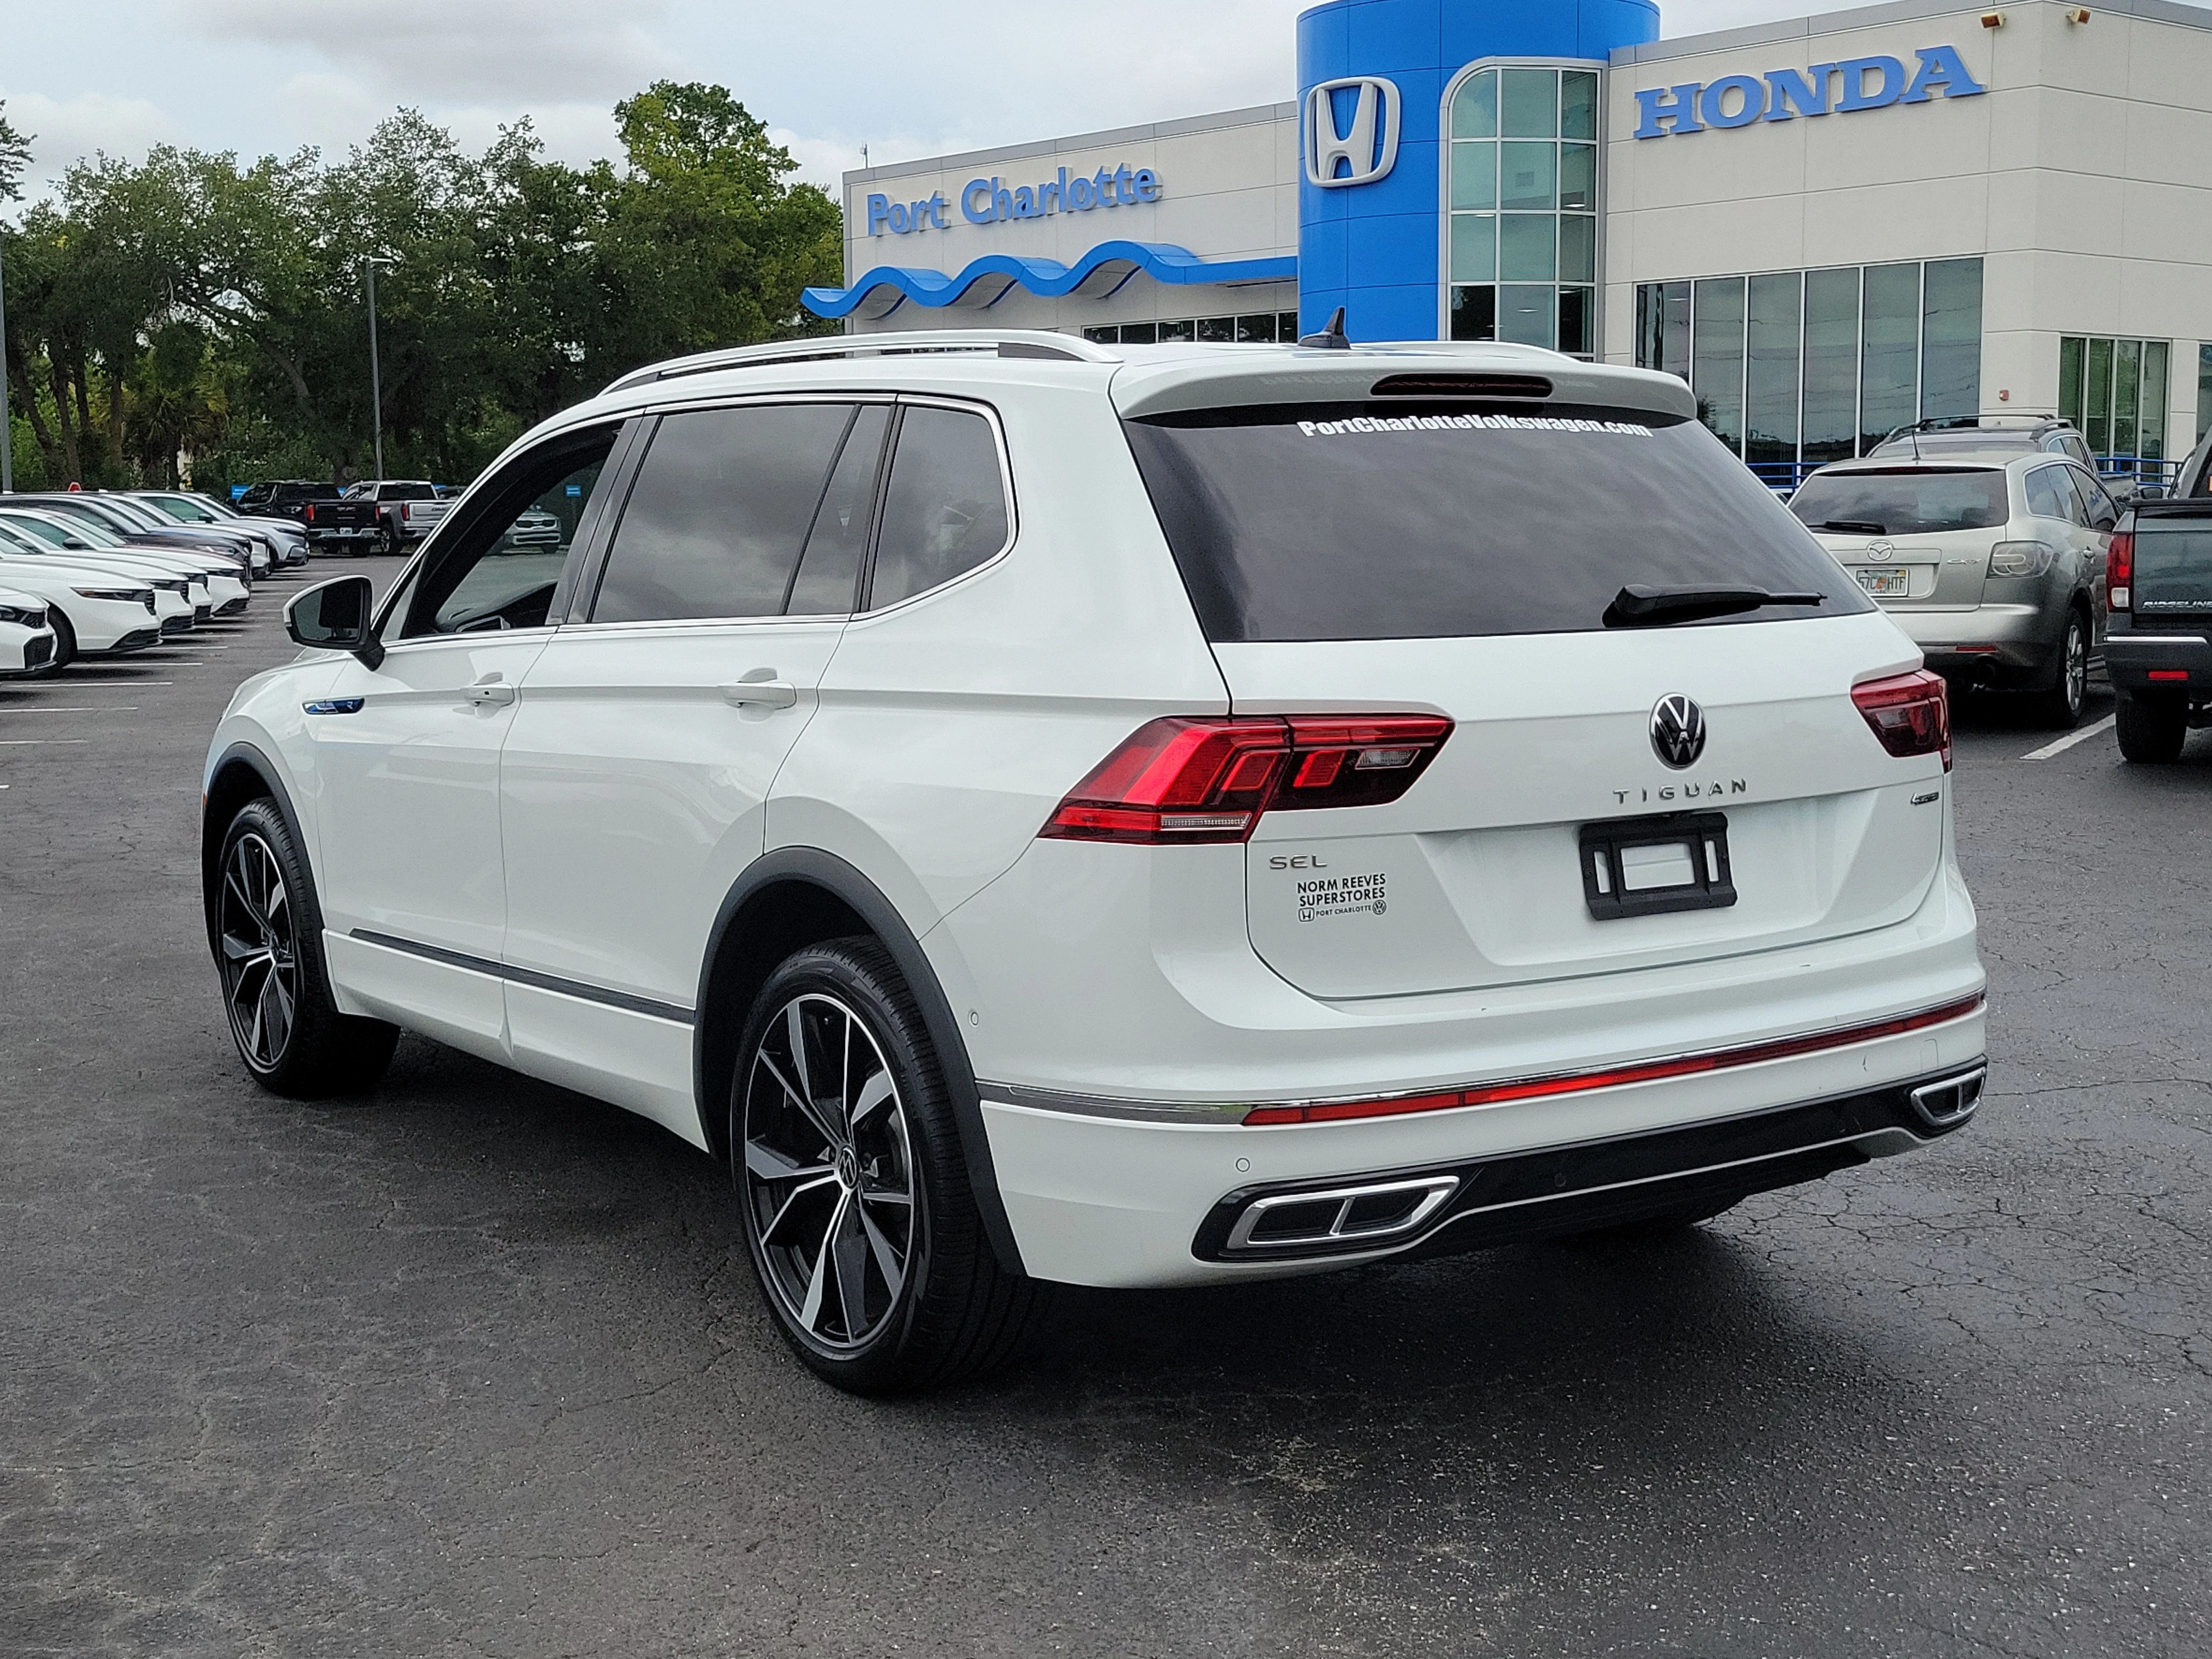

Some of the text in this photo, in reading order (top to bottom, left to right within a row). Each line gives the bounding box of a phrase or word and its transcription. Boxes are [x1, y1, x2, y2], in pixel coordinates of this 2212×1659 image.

[1633, 44, 1986, 139] HONDA
[867, 162, 1163, 236] Port Charlotte
[1296, 414, 1654, 438] PortCharlotteVolkswagen.com
[1613, 778, 1746, 804] TIGUAN
[1269, 854, 1327, 870] SEL
[1297, 873, 1386, 894] NORM REEVES
[1299, 887, 1385, 907] SUPERSTORES
[1334, 905, 1371, 915] CHARLOTTE
